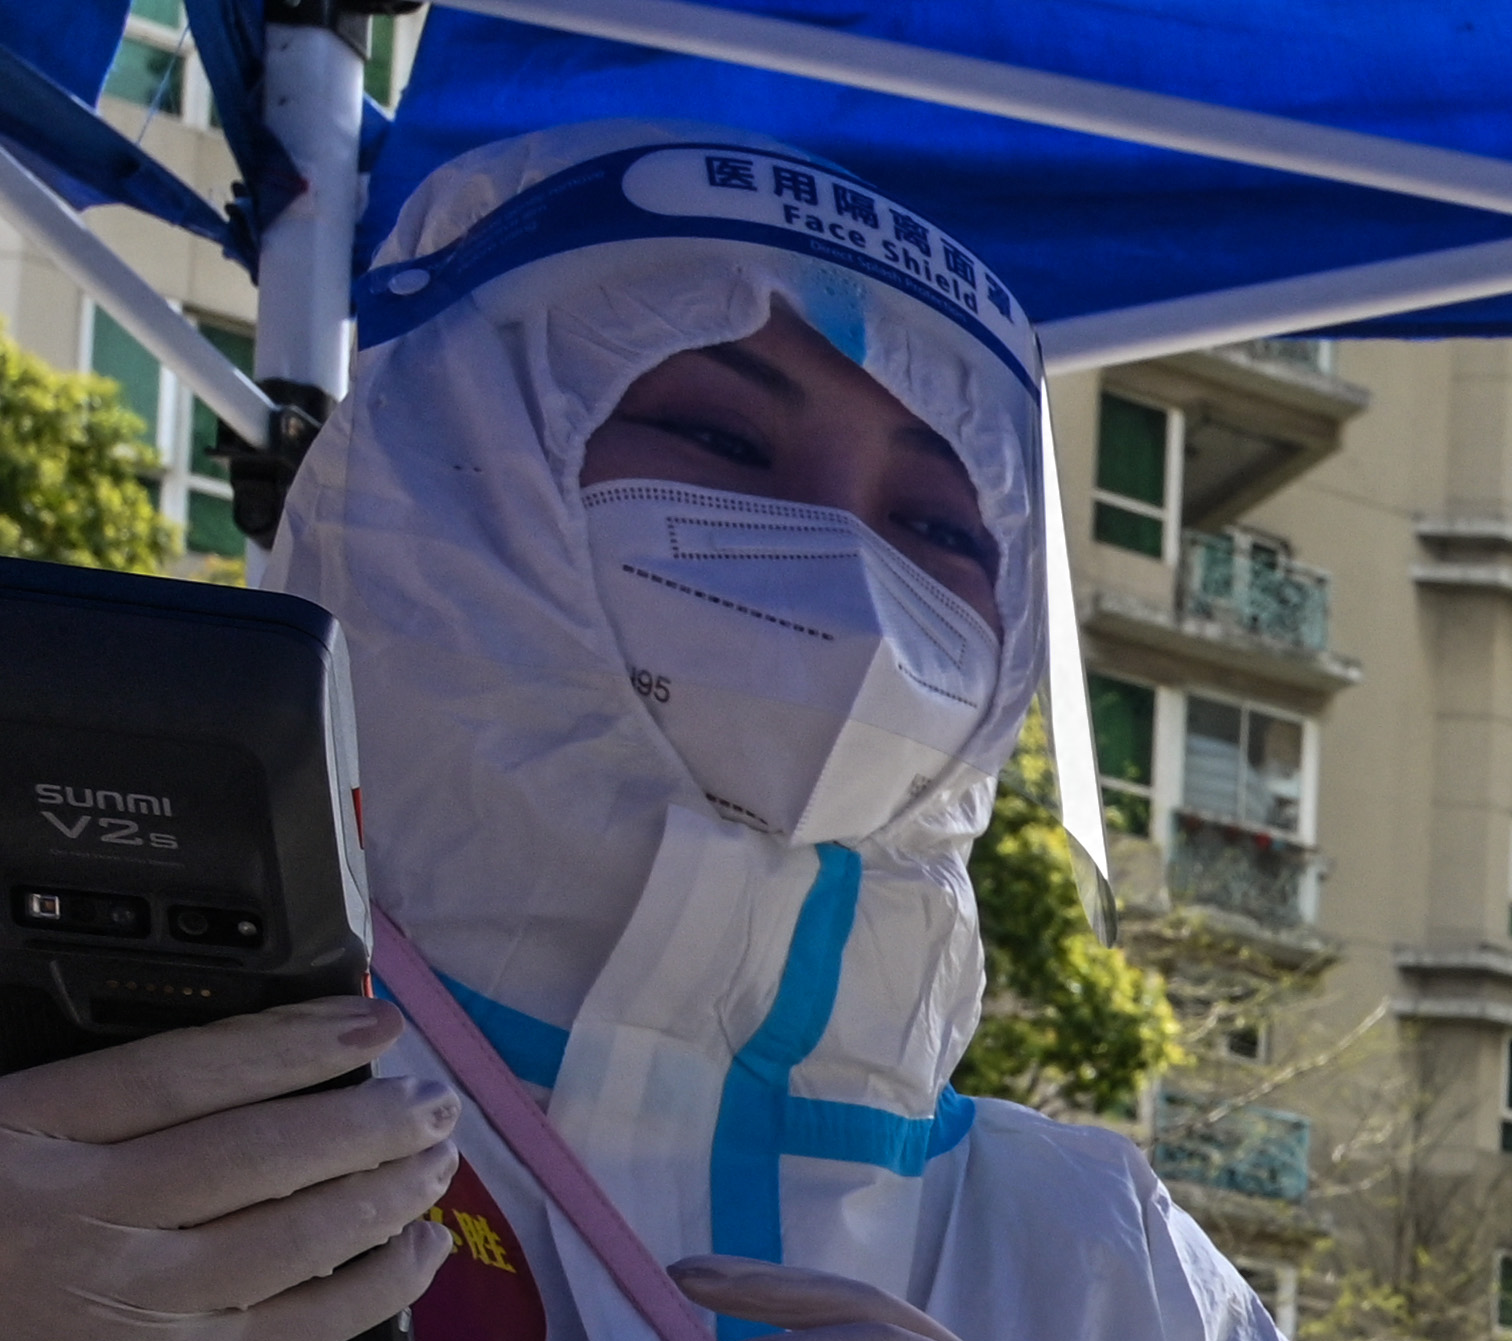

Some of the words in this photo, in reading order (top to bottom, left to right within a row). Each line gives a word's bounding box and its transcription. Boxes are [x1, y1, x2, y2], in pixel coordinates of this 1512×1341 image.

[704, 155, 1015, 325] 医用隔离面罩
[782, 203, 867, 249] Face
[881, 238, 980, 315] Shield
